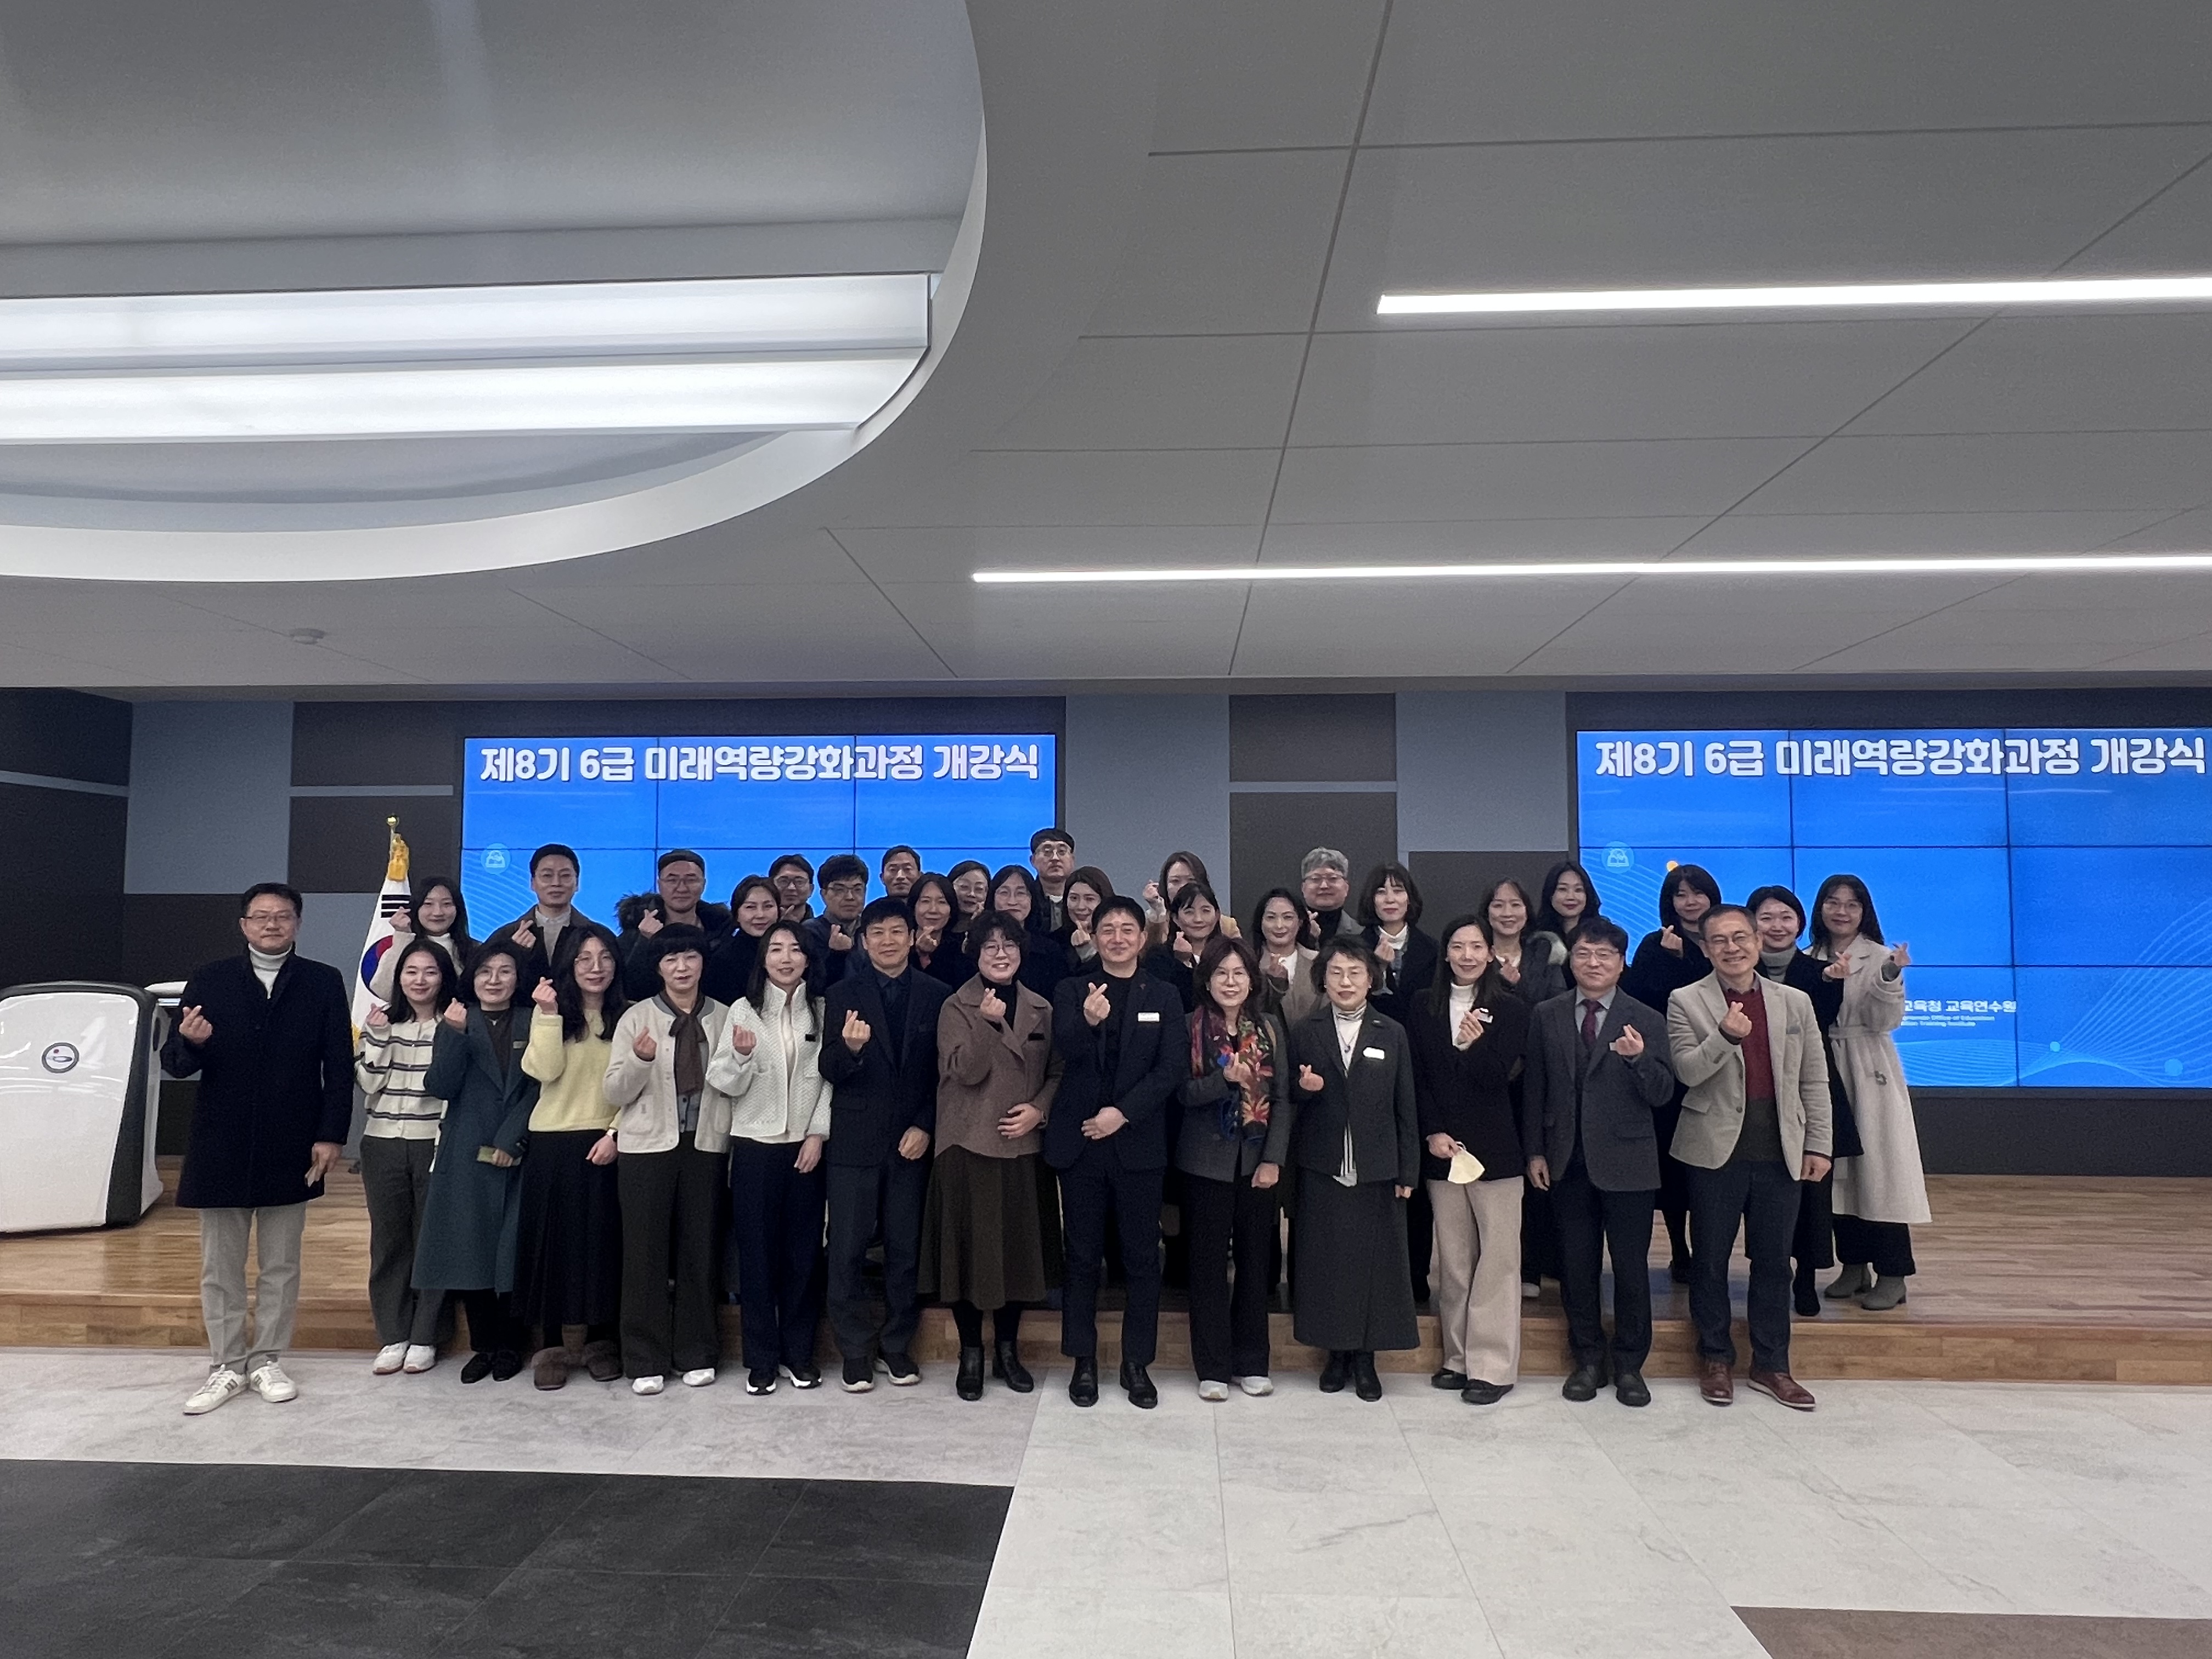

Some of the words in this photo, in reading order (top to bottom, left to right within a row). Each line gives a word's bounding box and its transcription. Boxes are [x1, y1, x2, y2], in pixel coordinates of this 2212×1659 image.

[481, 747, 570, 782] 제8기
[580, 747, 635, 781] 6급
[645, 744, 923, 781] 미래역량강화과정
[933, 744, 1039, 780] 개강식
[1595, 740, 1694, 777] 제8기
[1705, 740, 1765, 776] 6급
[1776, 738, 2080, 776] 미래역량강화과정
[2090, 737, 2206, 774] 개강식
[1945, 1000, 2017, 1013] 교육연수원
